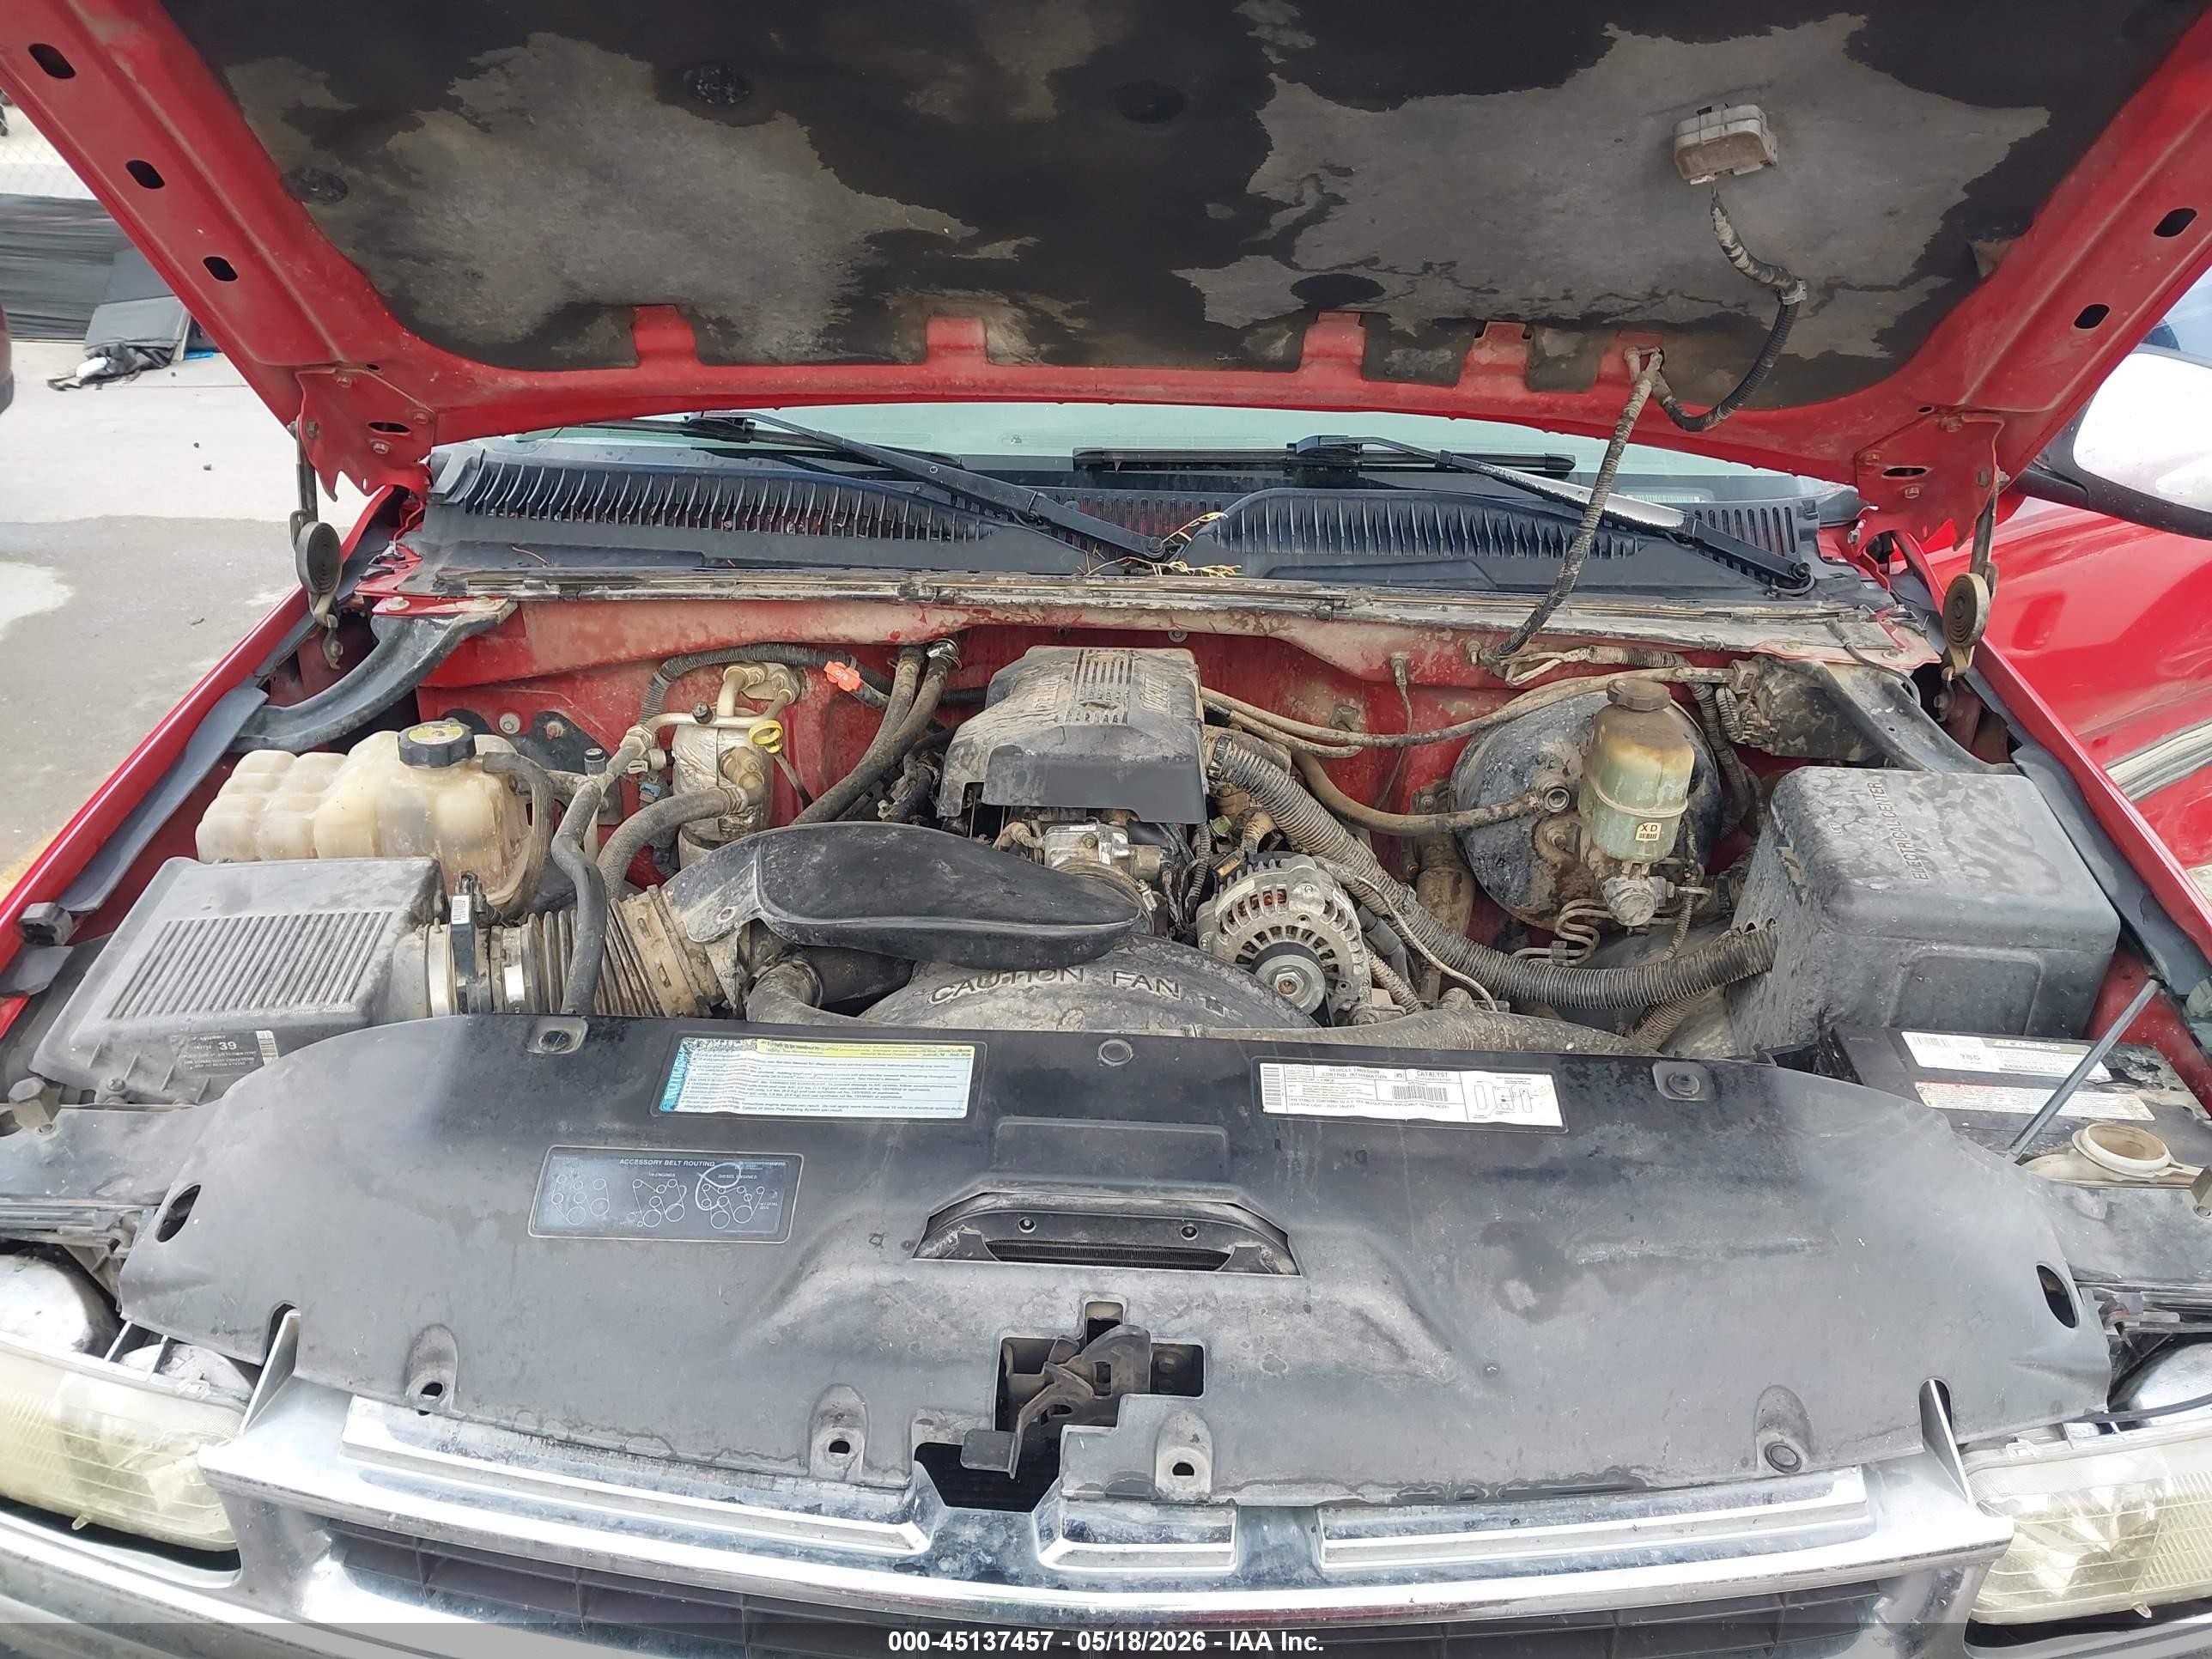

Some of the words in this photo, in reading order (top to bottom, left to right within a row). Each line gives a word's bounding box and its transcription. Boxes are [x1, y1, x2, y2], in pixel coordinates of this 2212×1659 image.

[1867, 782, 1898, 818] CENTER
[1887, 820, 1929, 880] ELECTRICAL
[928, 967, 1085, 1004] CAUTION
[1112, 969, 1182, 1000] FAN
[218, 1041, 237, 1051] 39
[1993, 1038, 2063, 1052] ACDelco
[619, 1158, 662, 1166] ACCESSORY
